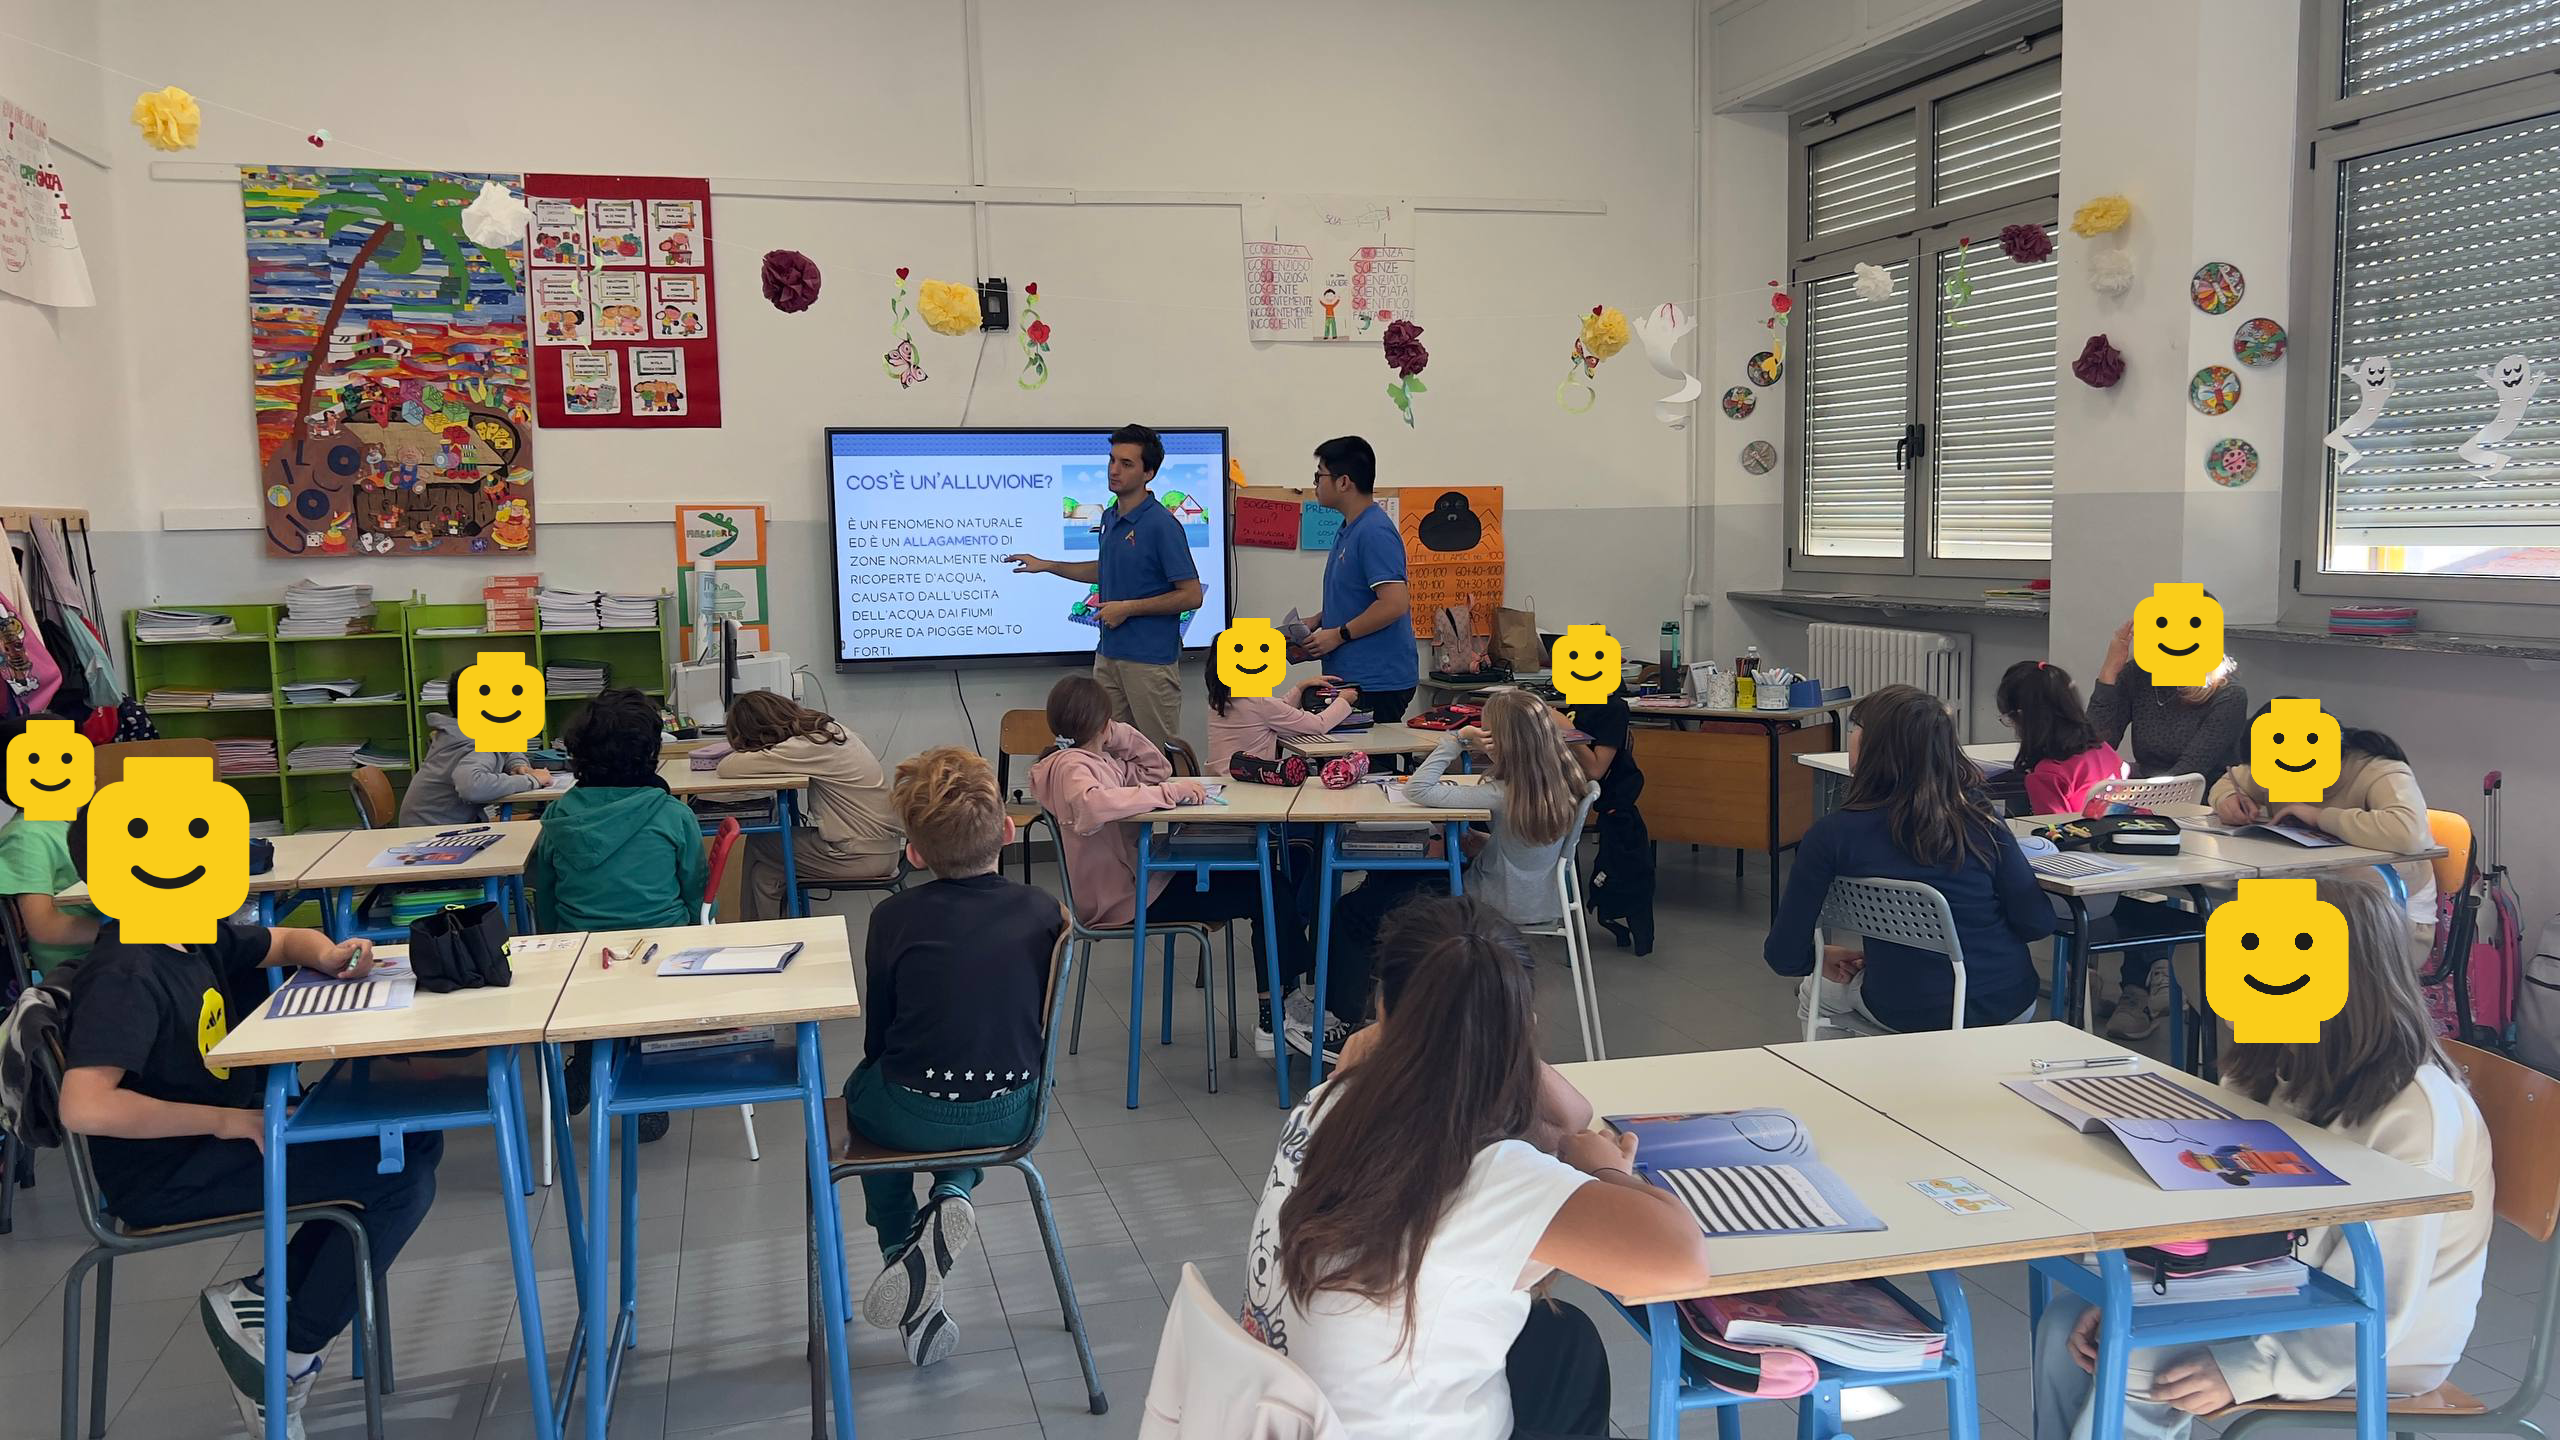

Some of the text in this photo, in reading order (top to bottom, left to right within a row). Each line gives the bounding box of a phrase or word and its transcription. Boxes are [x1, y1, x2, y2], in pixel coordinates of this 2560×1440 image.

[1354, 260, 1399, 274] SCIENZE
[846, 470, 1053, 490] COS'È UN'ALLUVIONE?
[848, 517, 1023, 530] È UN FENOMENO NATURALE
[849, 535, 1013, 548] ED È UN ALLAGAMENTO DI
[850, 556, 886, 567] ZONE
[889, 554, 987, 565] NORMALMENTE
[1407, 554, 1426, 563] UTTI
[850, 572, 986, 584] RICOPERTE D'ACQUA,
[851, 589, 1000, 603] CAUSATO DALL'USCITA
[852, 608, 993, 621] DELL'ACQUA DAI FIUMI
[853, 624, 1023, 639] OPPURE DA PIOGGE MOLTO
[853, 646, 894, 657] FORTI.
